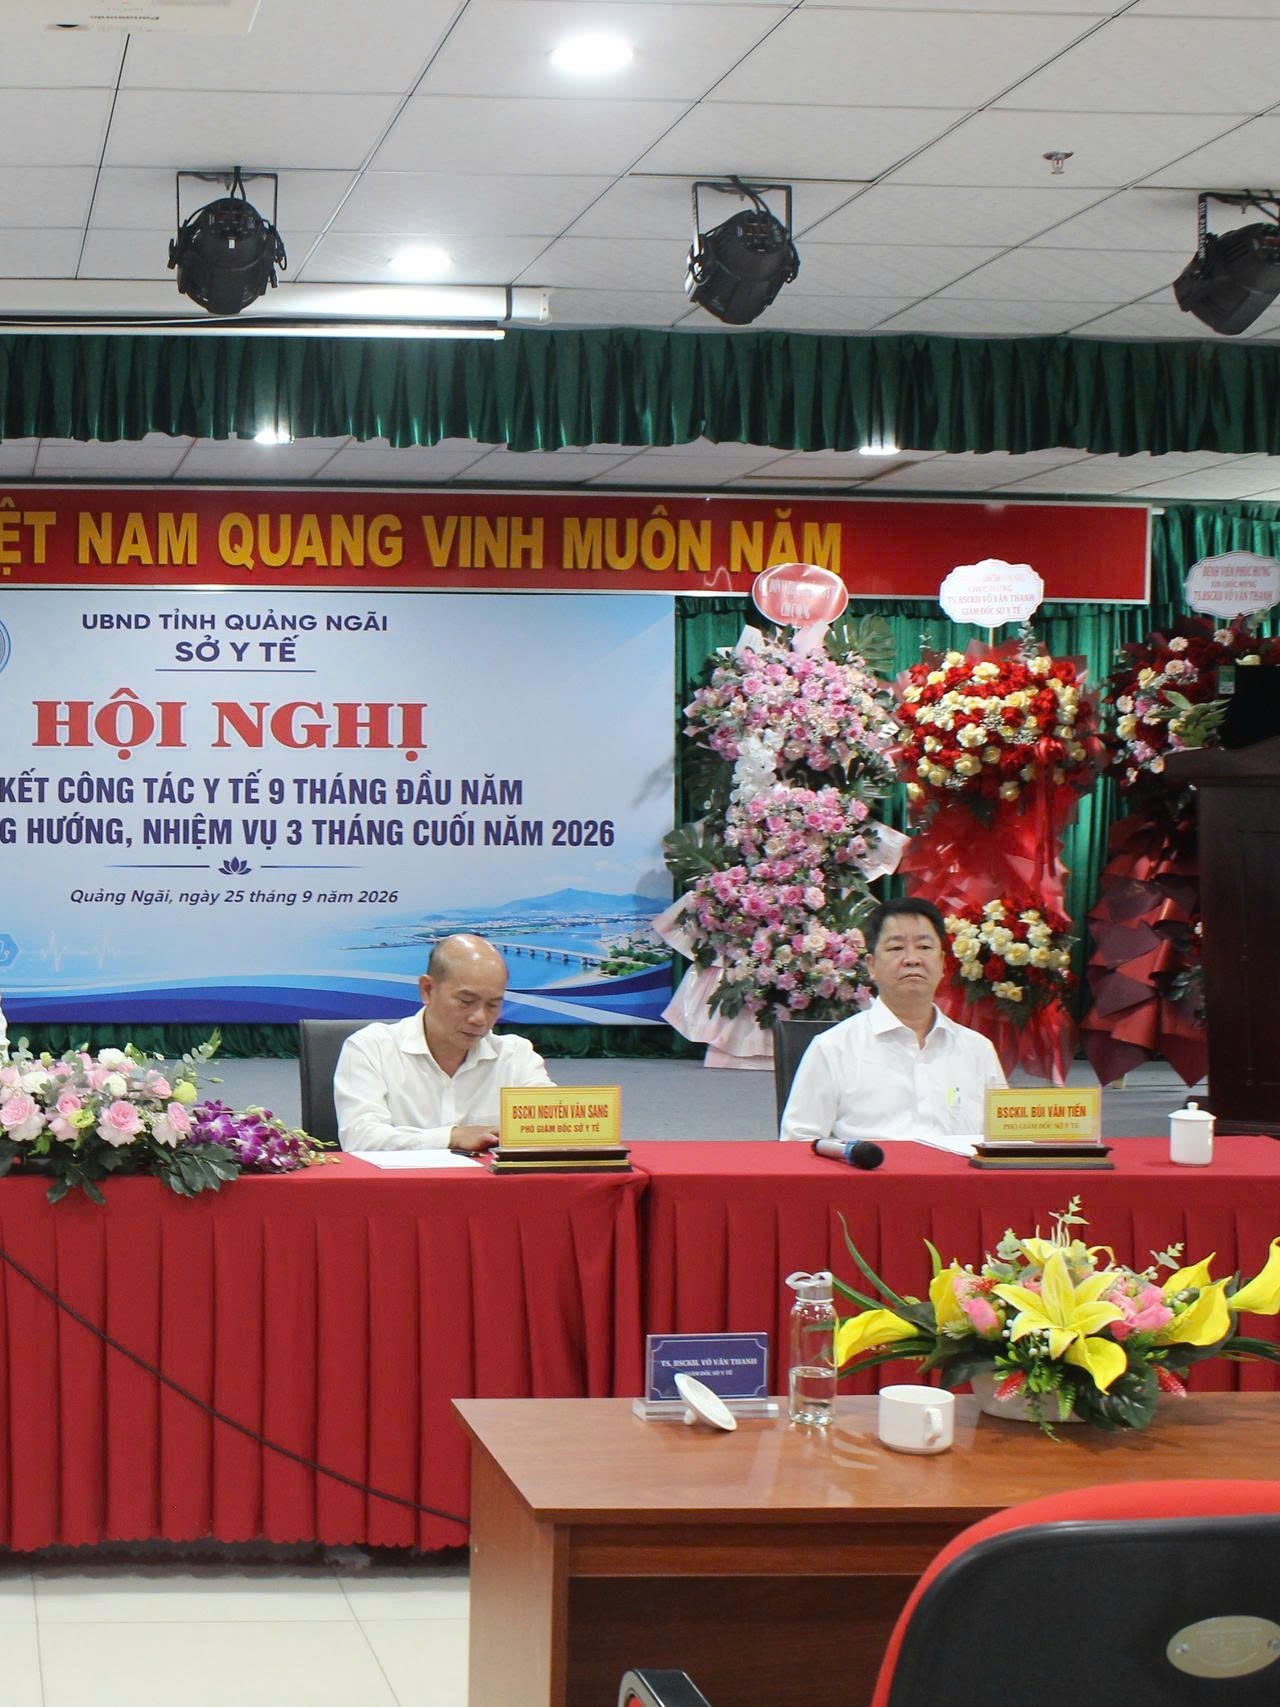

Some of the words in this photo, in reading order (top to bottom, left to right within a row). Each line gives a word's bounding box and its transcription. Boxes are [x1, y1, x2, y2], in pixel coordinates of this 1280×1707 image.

[78, 512, 197, 566] NAM
[218, 512, 403, 570] QUANG
[422, 515, 544, 569] VINH
[562, 505, 711, 572] MUÔN
[730, 508, 841, 573] NĂM
[82, 613, 151, 631] UBND
[159, 609, 216, 631] TỈNH
[225, 609, 317, 632] QUẢNG
[326, 611, 388, 632] NGÃI
[175, 635, 221, 664] SỞ
[230, 642, 250, 663] Y
[259, 634, 300, 663] TẾ
[32, 687, 187, 761] HỘI
[211, 701, 428, 762] NGHỊ
[0, 768, 49, 803] KẾT
[58, 771, 134, 804] CÔNG
[143, 772, 195, 804] TÁC
[204, 778, 221, 804] Y
[229, 769, 263, 804] TẾ
[268, 778, 285, 805] 9
[293, 772, 387, 805] THÁNG
[396, 769, 451, 805] ĐẦU
[462, 773, 523, 805] NĂM
[27, 811, 133, 848] HƯỚNG,
[143, 813, 233, 850] NHIỆM
[242, 819, 277, 850] VỤ
[287, 819, 303, 846] 3
[312, 814, 403, 846] THÁNG
[413, 811, 475, 846] CUỐI
[484, 815, 543, 846] NĂM
[552, 819, 615, 847] 2026
[70, 888, 125, 905] Quảng
[131, 889, 173, 905] Ngãi,
[179, 890, 219, 906] ngày
[224, 890, 244, 903] 25
[249, 890, 297, 906] tháng
[302, 890, 312, 904] 9
[317, 890, 353, 904] năm
[358, 890, 399, 904] 2026
[538, 1100, 568, 1119] NGUYỄN
[571, 1102, 586, 1119] VĂN
[587, 1104, 608, 1118] SANG
[1031, 1104, 1045, 1117] BÙI
[1048, 1104, 1065, 1117] VĂN
[1067, 1103, 1086, 1117] TIẾN
[521, 1124, 534, 1133] PHÓ
[537, 1123, 555, 1133] GIÁM
[557, 1123, 571, 1133] ĐỐC
[574, 1123, 583, 1132] SỞ
[592, 1122, 600, 1132] TẾ
[701, 1357, 712, 1366] VÕ
[712, 1357, 728, 1365] VĂN
